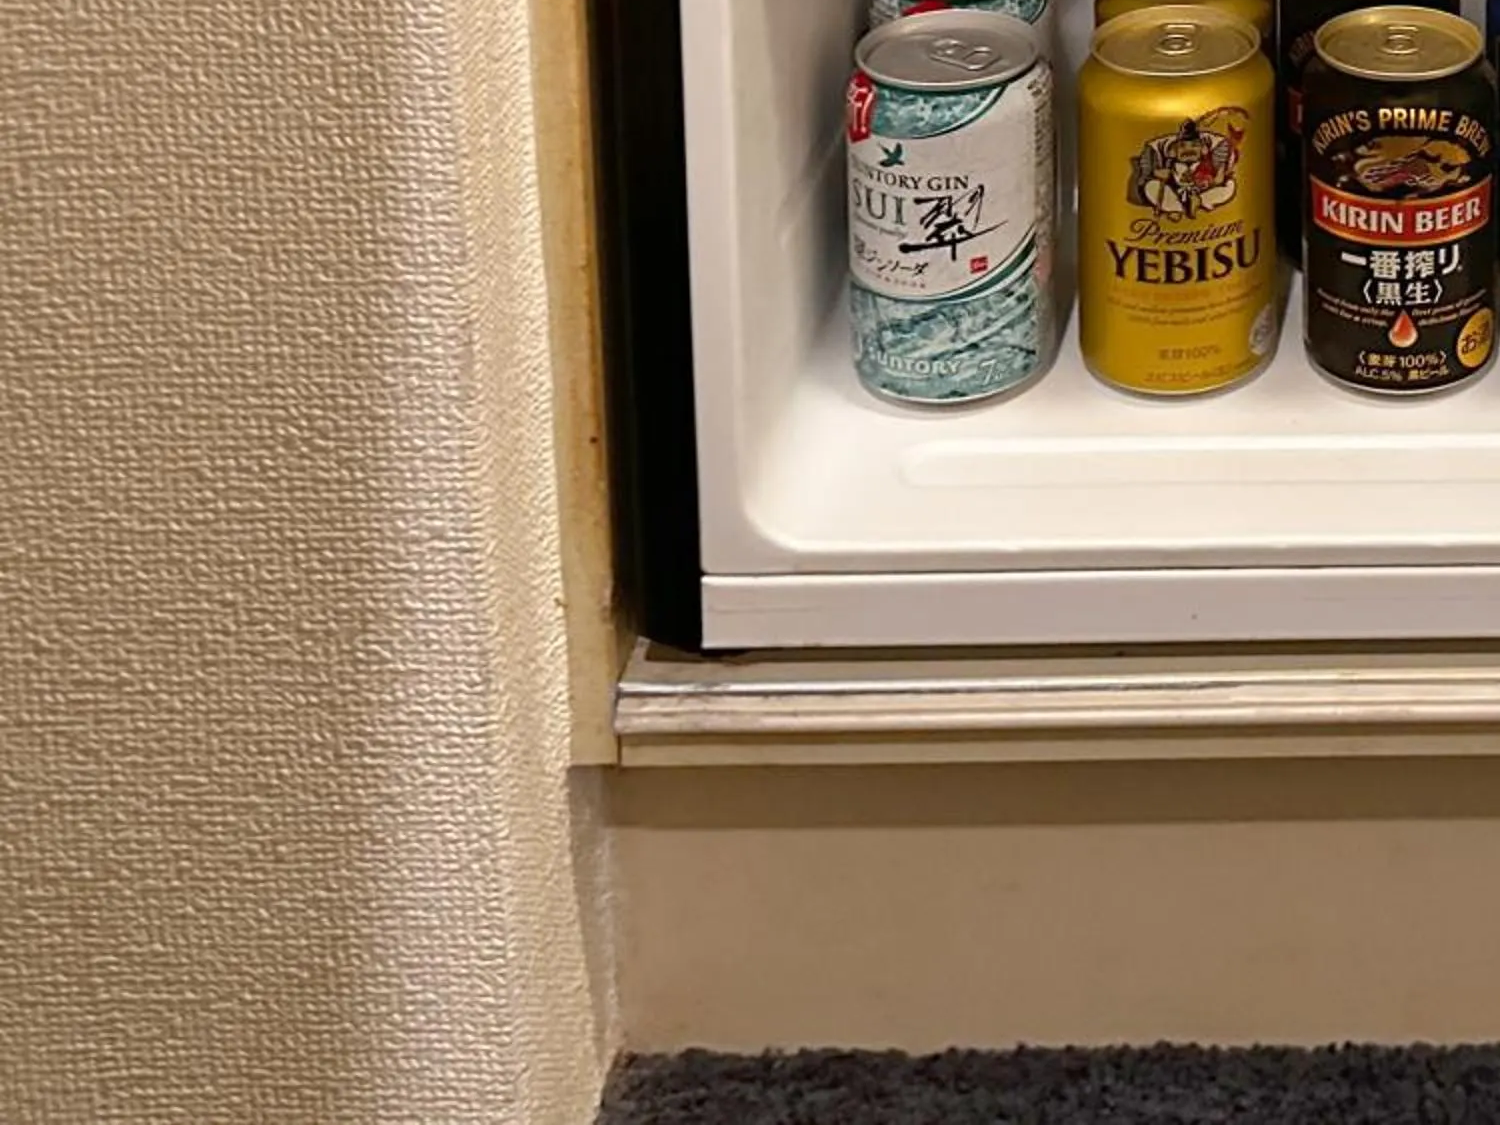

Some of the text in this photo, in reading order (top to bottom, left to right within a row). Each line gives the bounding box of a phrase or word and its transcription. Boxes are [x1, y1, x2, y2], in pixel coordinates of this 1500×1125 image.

[1312, 111, 1372, 155] KIRIN'S
[1378, 108, 1454, 133] PRIME
[852, 178, 907, 226] SUI
[926, 175, 970, 192] GIN
[1124, 218, 1244, 245] Premium
[1322, 196, 1481, 234] KIRIN BEER
[1105, 229, 1261, 284] YEBISU
[1341, 244, 1461, 279] 一番搾り
